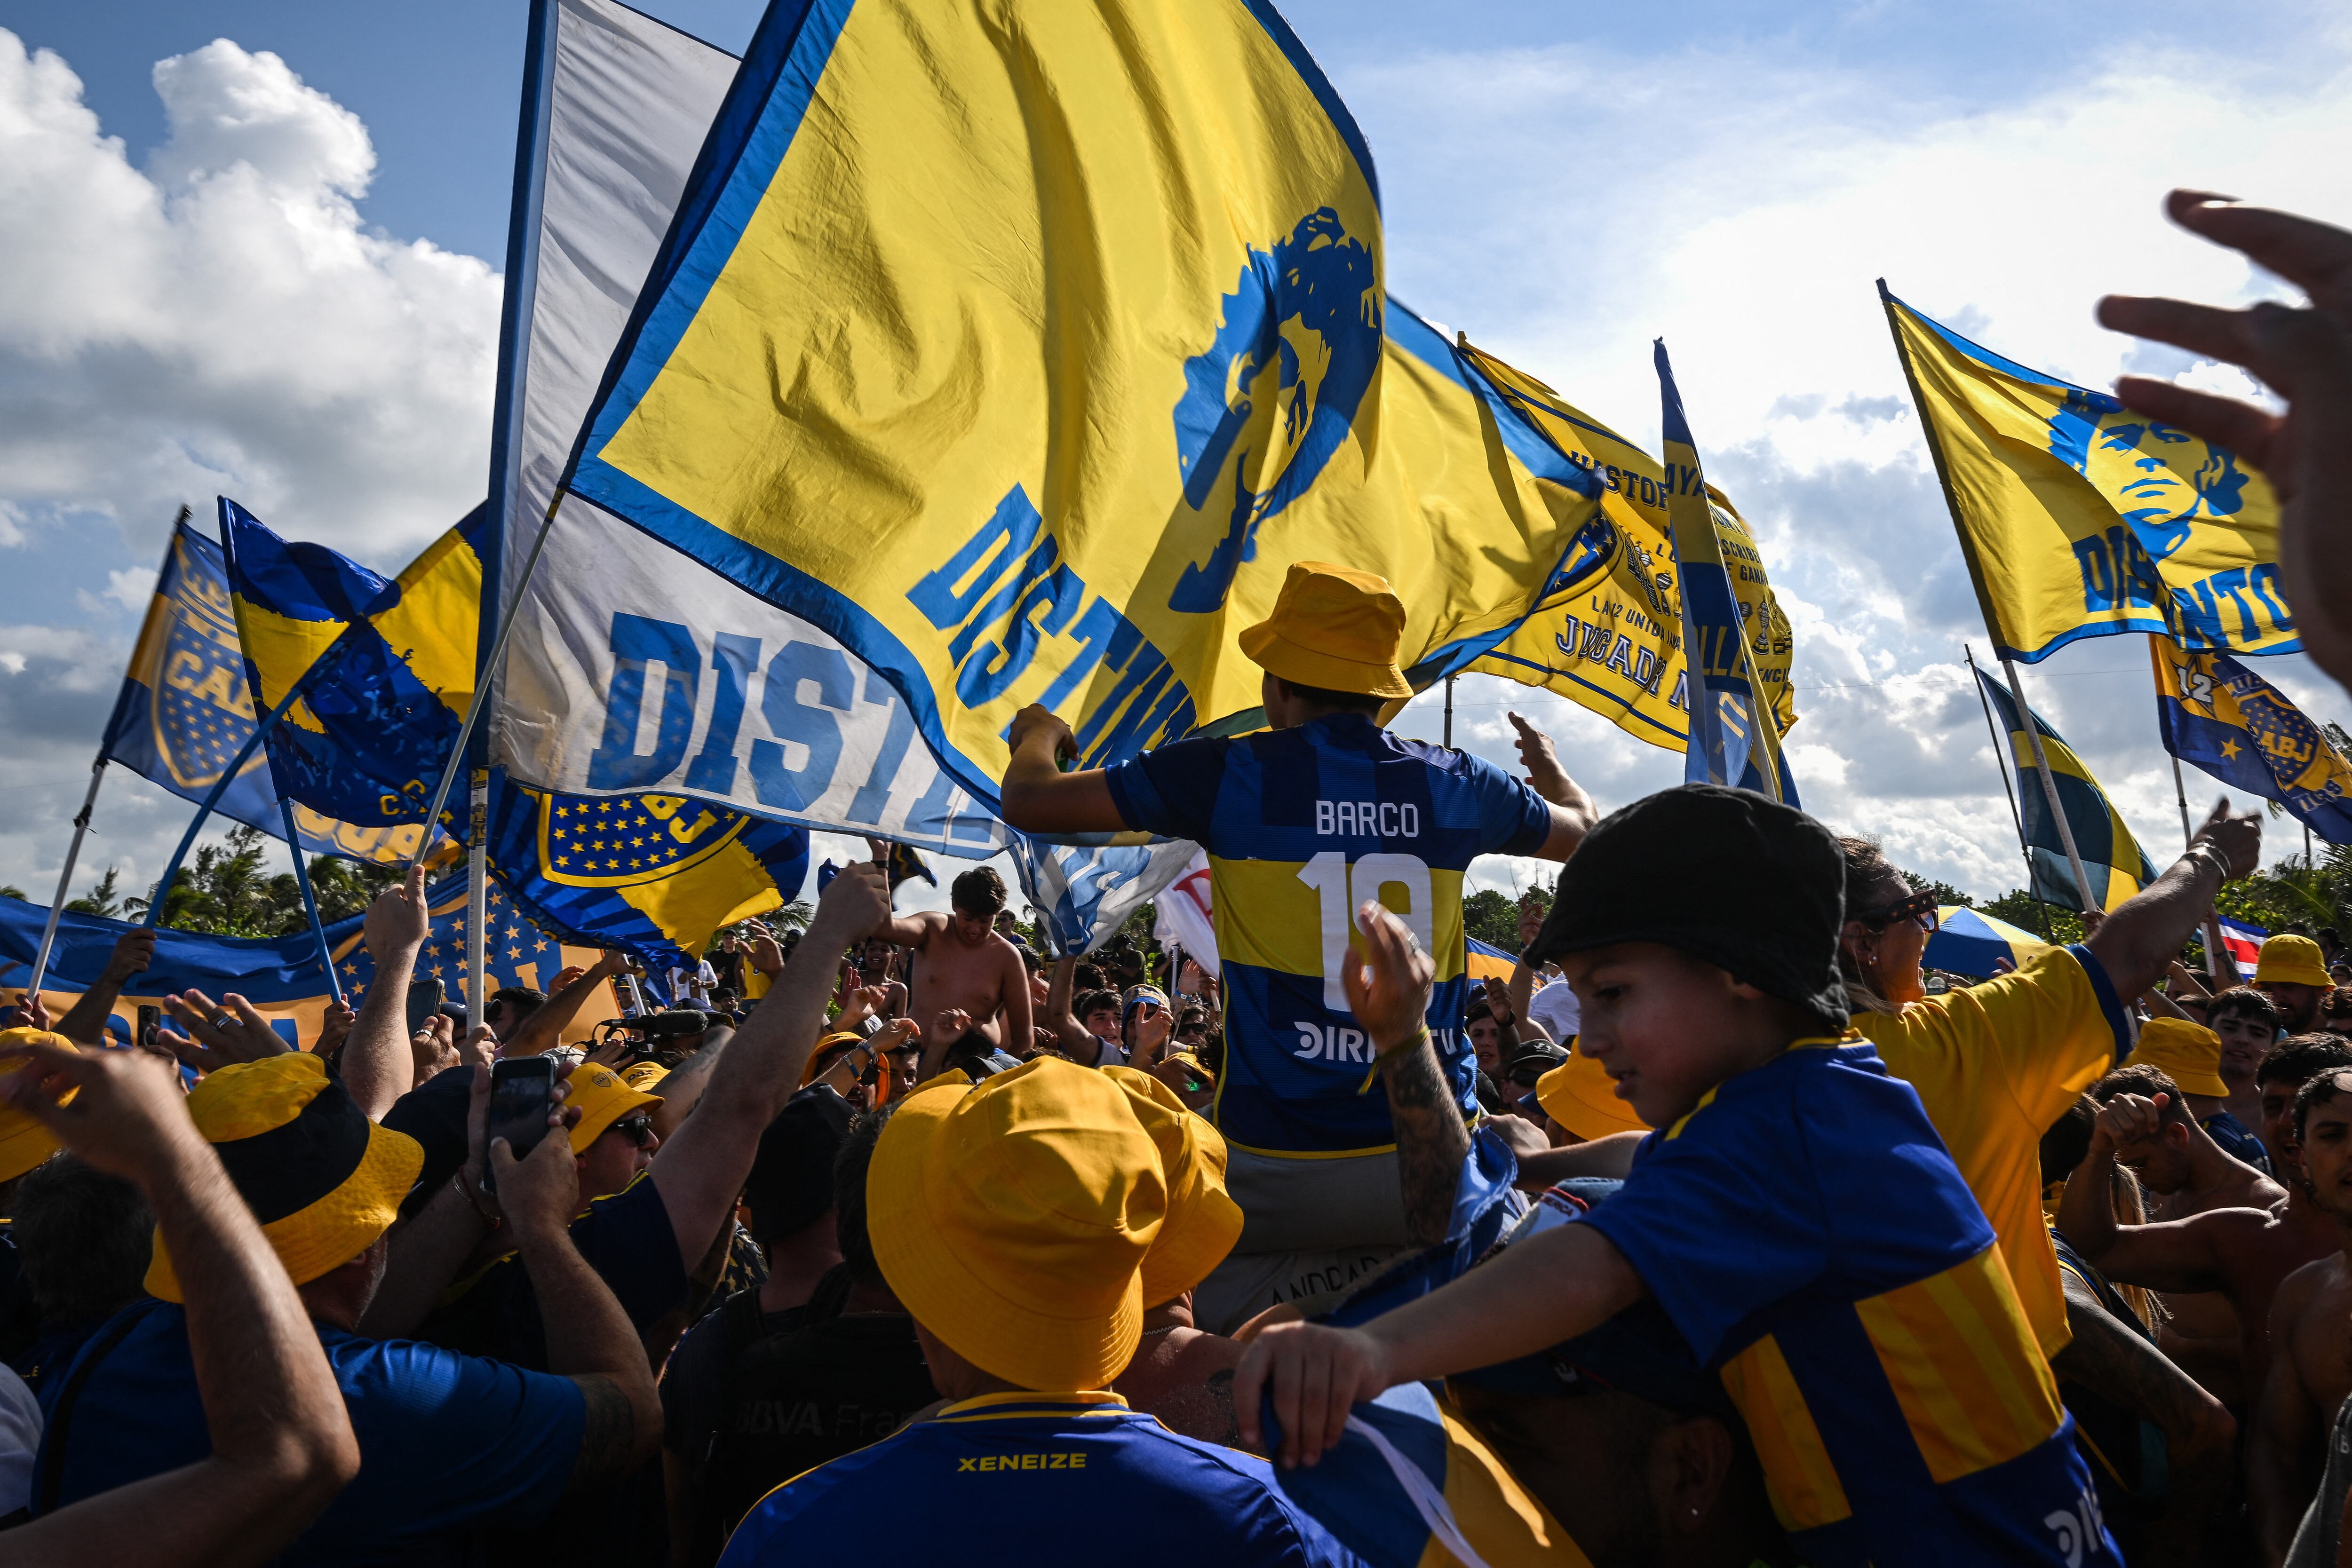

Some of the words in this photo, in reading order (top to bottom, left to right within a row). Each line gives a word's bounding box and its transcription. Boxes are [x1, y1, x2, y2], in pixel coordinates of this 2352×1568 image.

[1721, 539, 1760, 564] SCRIBE
[2177, 666, 2213, 704] 12
[1316, 800, 1419, 837] BARCO
[1293, 1021, 1458, 1064] DIRV
[735, 1400, 824, 1436] BBVA
[957, 1452, 1088, 1473] XENEIZE
